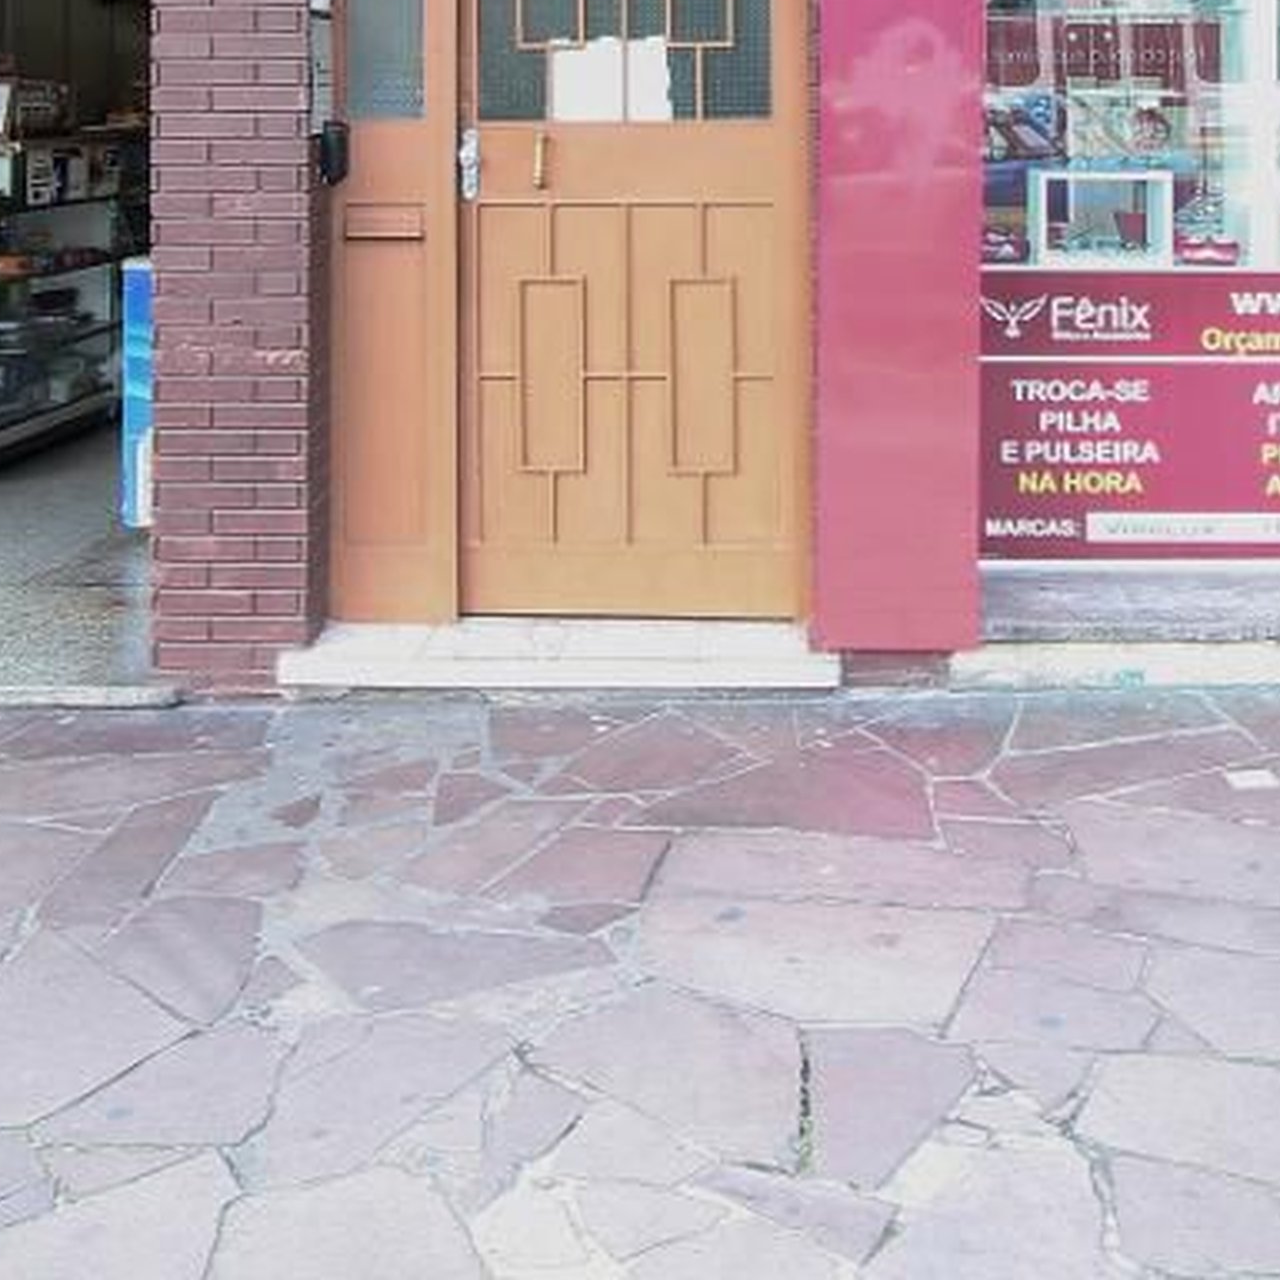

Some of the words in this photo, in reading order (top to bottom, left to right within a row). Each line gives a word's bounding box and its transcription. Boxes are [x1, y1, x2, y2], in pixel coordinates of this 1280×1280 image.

[1051, 296, 1152, 329] Fênix
[1011, 379, 1150, 402] TROCA-SE
[1038, 410, 1122, 433] PILHA
[1001, 440, 1019, 463] E
[1025, 440, 1161, 464] PULSEIRA
[1019, 471, 1057, 494] NA
[1063, 471, 1143, 494] HORA
